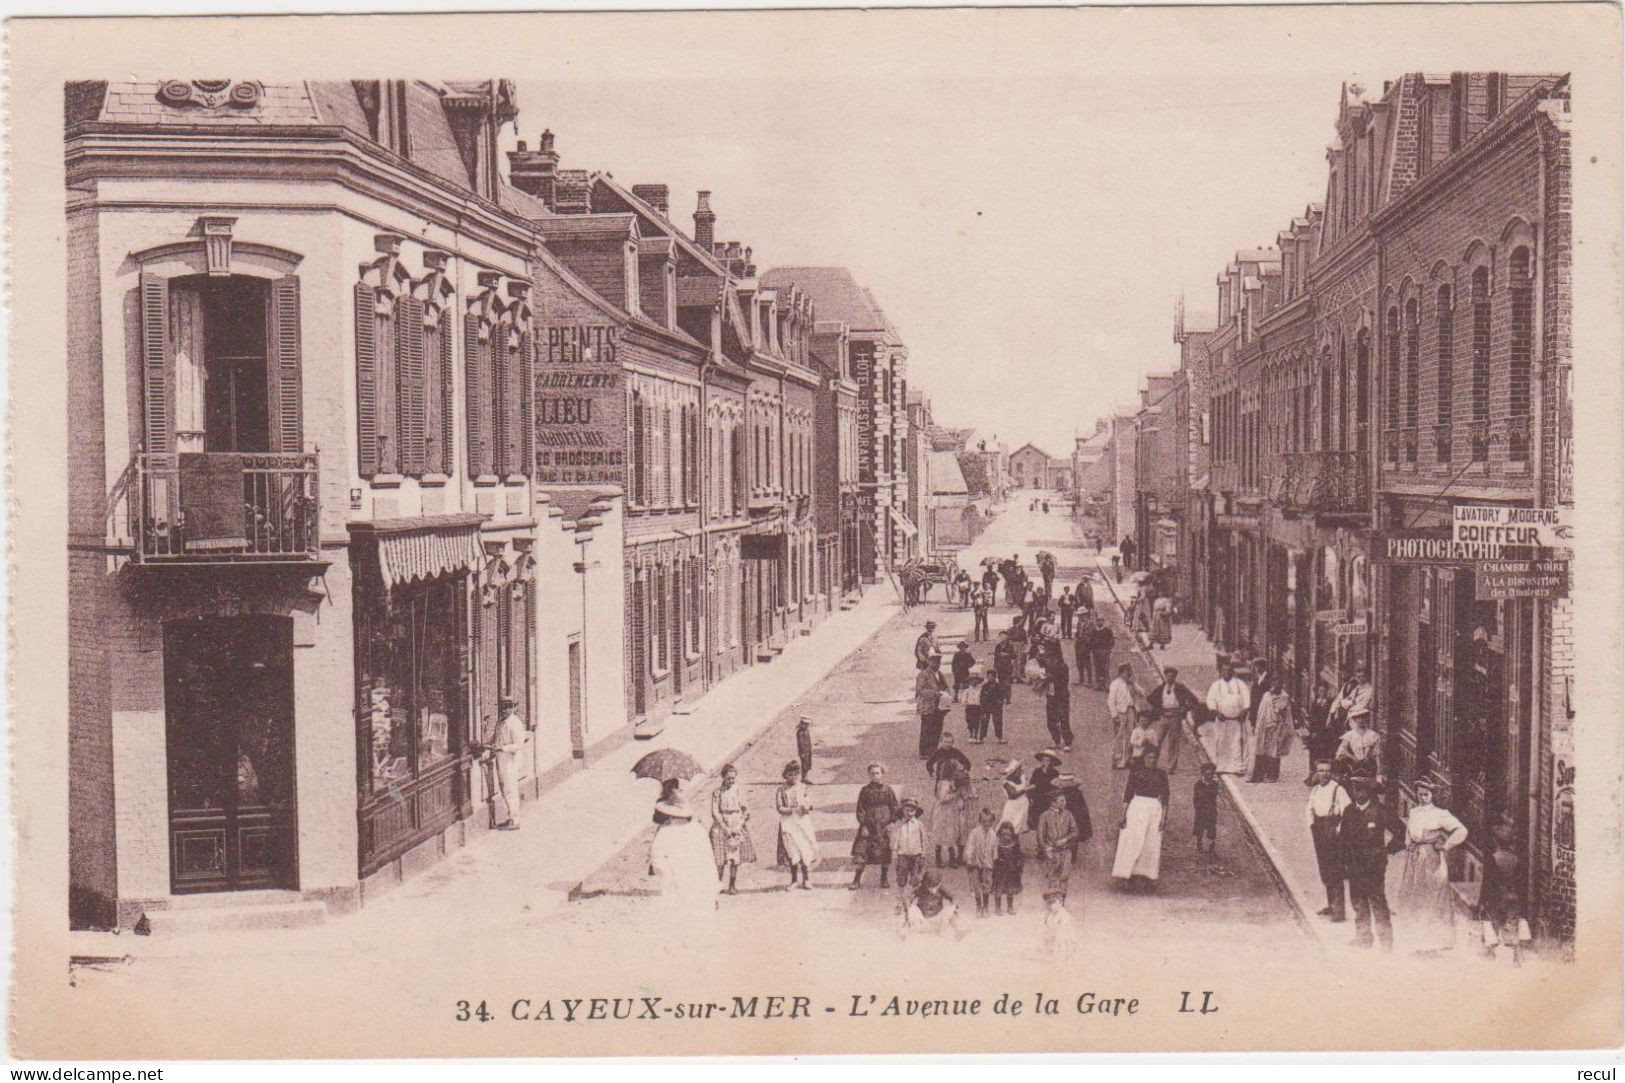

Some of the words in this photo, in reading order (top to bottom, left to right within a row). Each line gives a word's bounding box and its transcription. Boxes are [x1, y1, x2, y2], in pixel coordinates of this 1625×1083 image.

[548, 325, 616, 363] PEINTS
[857, 399, 870, 472] RESTAURANT
[555, 451, 622, 466] BROSSERIES
[598, 471, 622, 482] PARIS
[1455, 507, 1501, 523] LAVATORY
[1503, 510, 1559, 526] MODERNE
[1458, 525, 1542, 545] COIFFEUR
[1387, 538, 1505, 560] PHOTOGRAPHIE
[1483, 562, 1530, 572] CHAMBRE
[1536, 561, 1566, 572] NOIRE
[1492, 577, 1505, 587] LA
[1507, 576, 1560, 587] DISPOSITION
[1490, 588, 1506, 597] des
